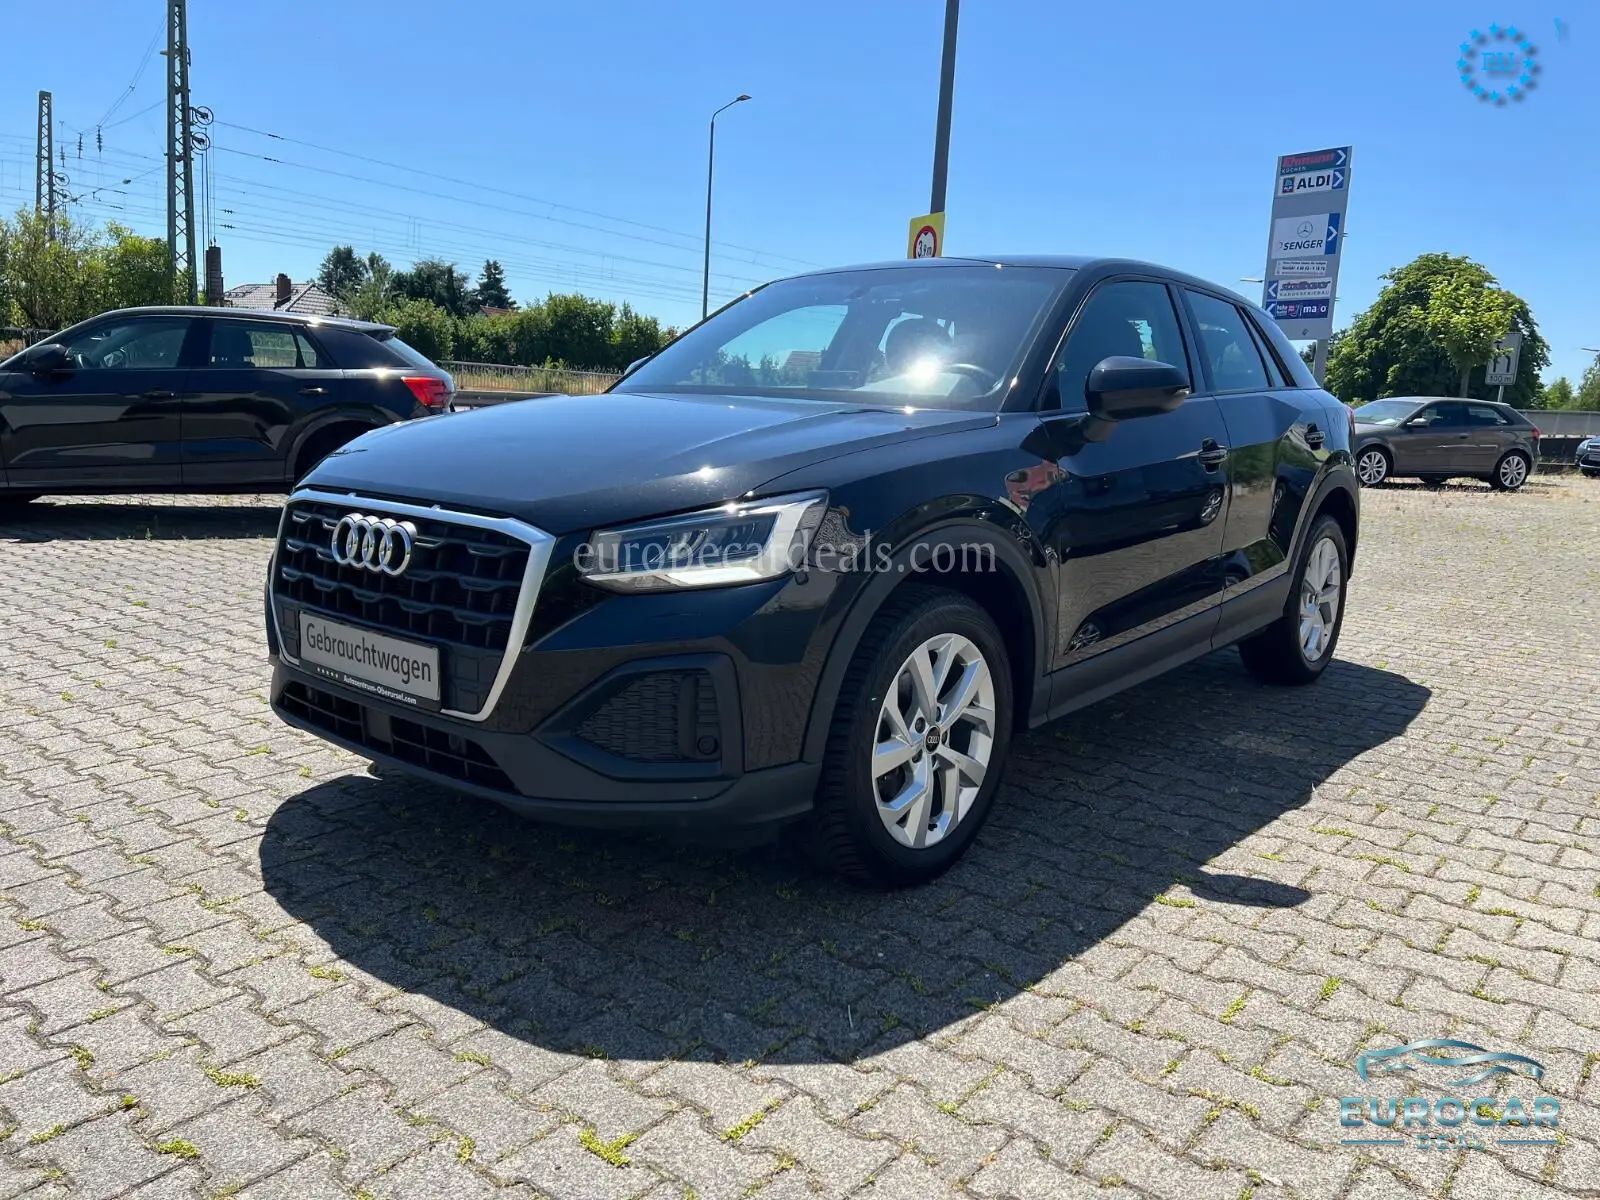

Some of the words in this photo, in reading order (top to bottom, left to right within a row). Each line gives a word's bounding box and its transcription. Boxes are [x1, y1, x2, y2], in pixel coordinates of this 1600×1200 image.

[1296, 174, 1331, 189] ALDI
[1283, 239, 1323, 251] SENGER
[306, 622, 432, 684] Gebrauchtwagen
